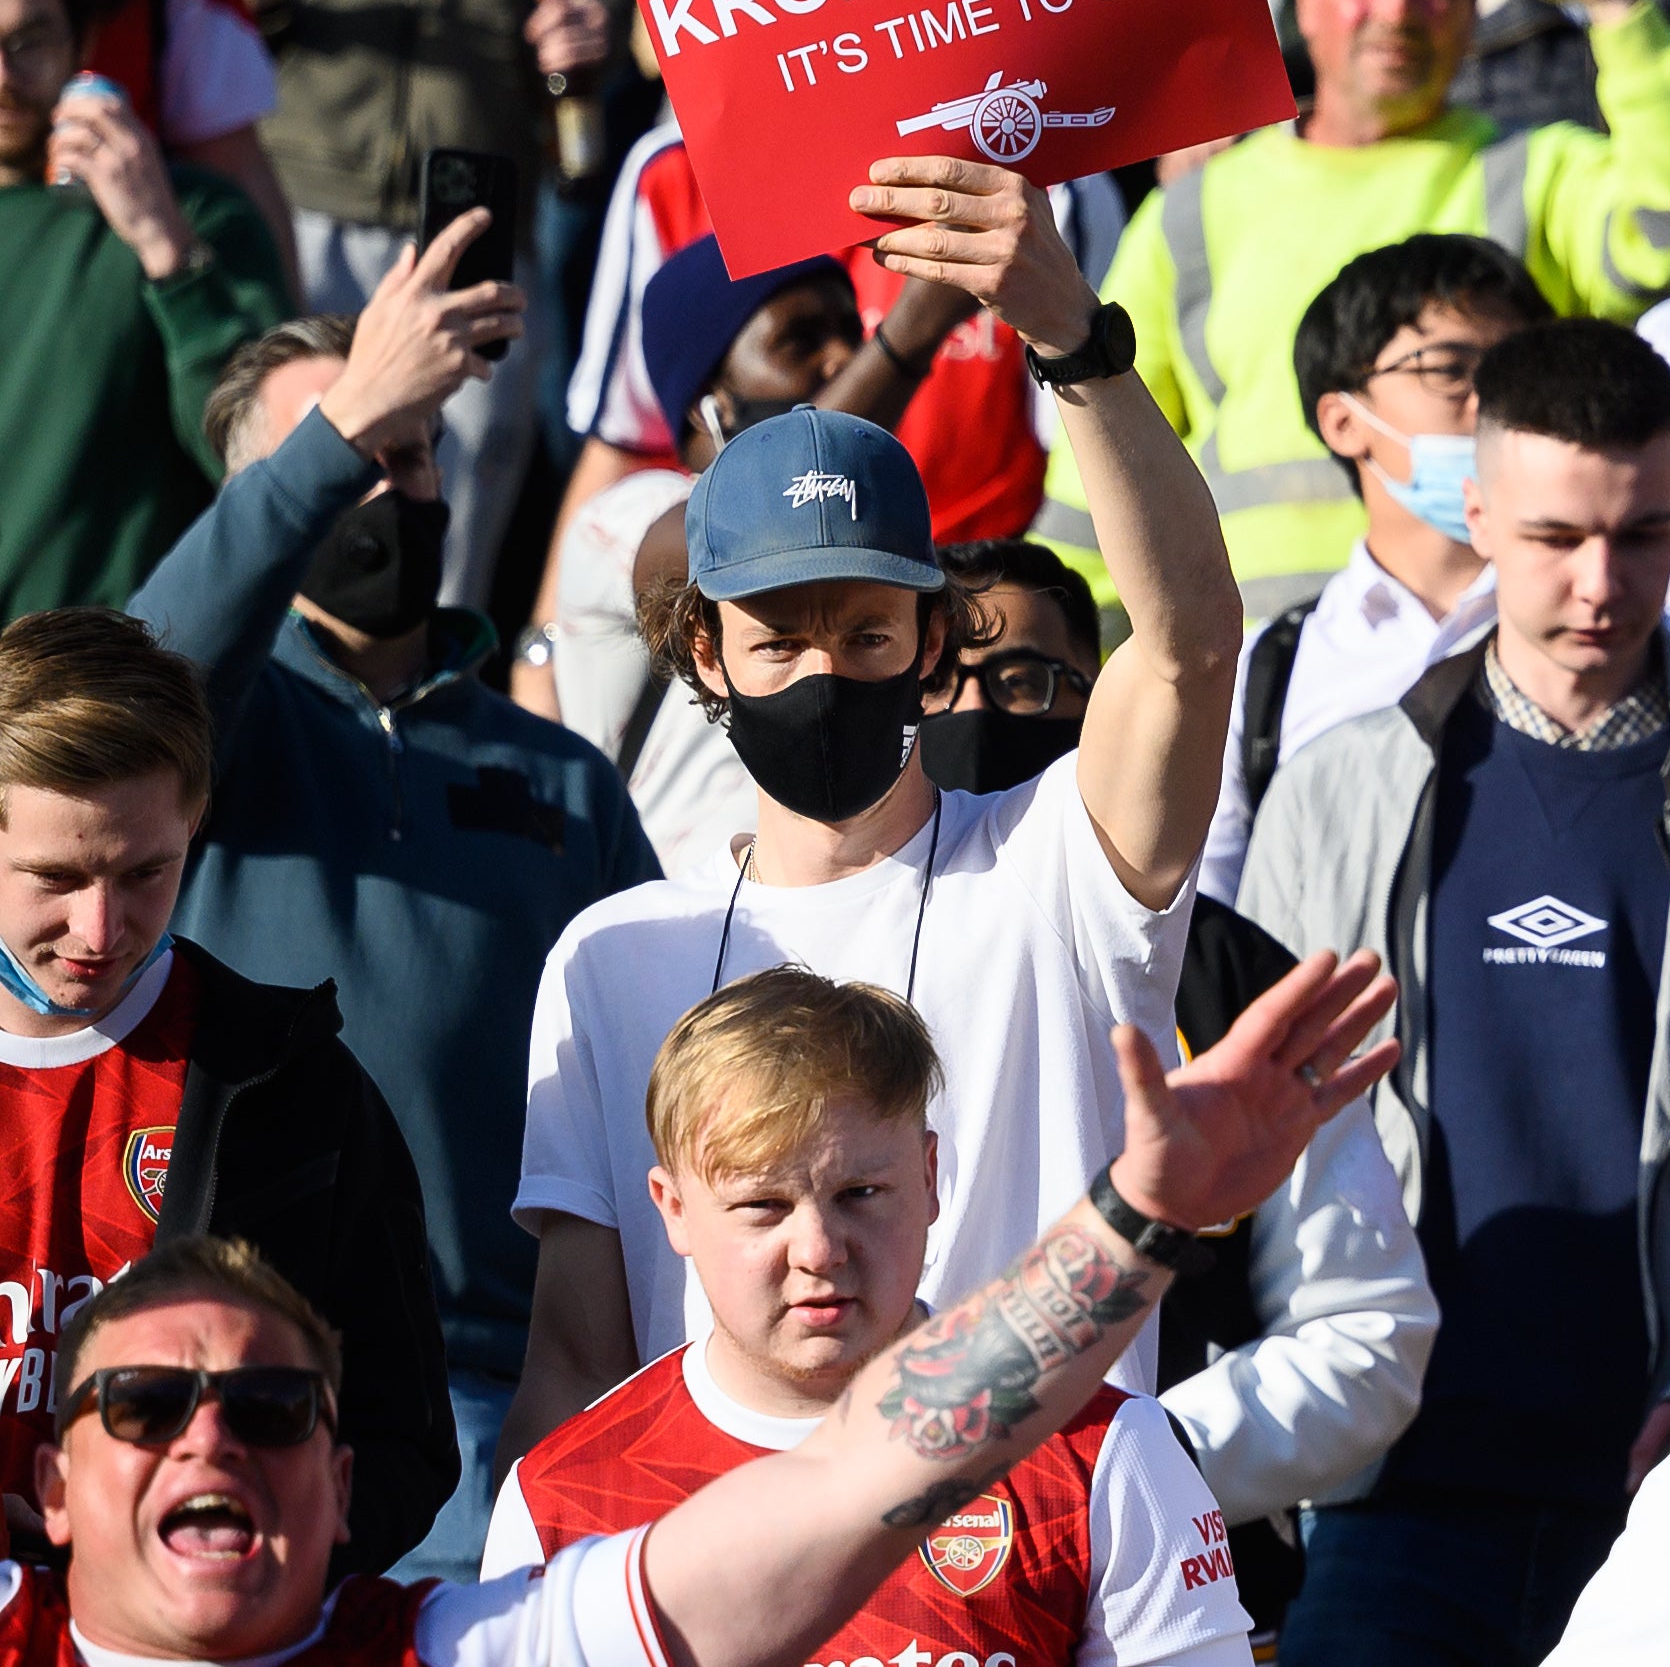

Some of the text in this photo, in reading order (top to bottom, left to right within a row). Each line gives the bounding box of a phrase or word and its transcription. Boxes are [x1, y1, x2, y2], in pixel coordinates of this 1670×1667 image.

[776, 33, 869, 93] IT'S
[941, 1510, 1000, 1529] rsenal
[1192, 1509, 1226, 1546] VIS
